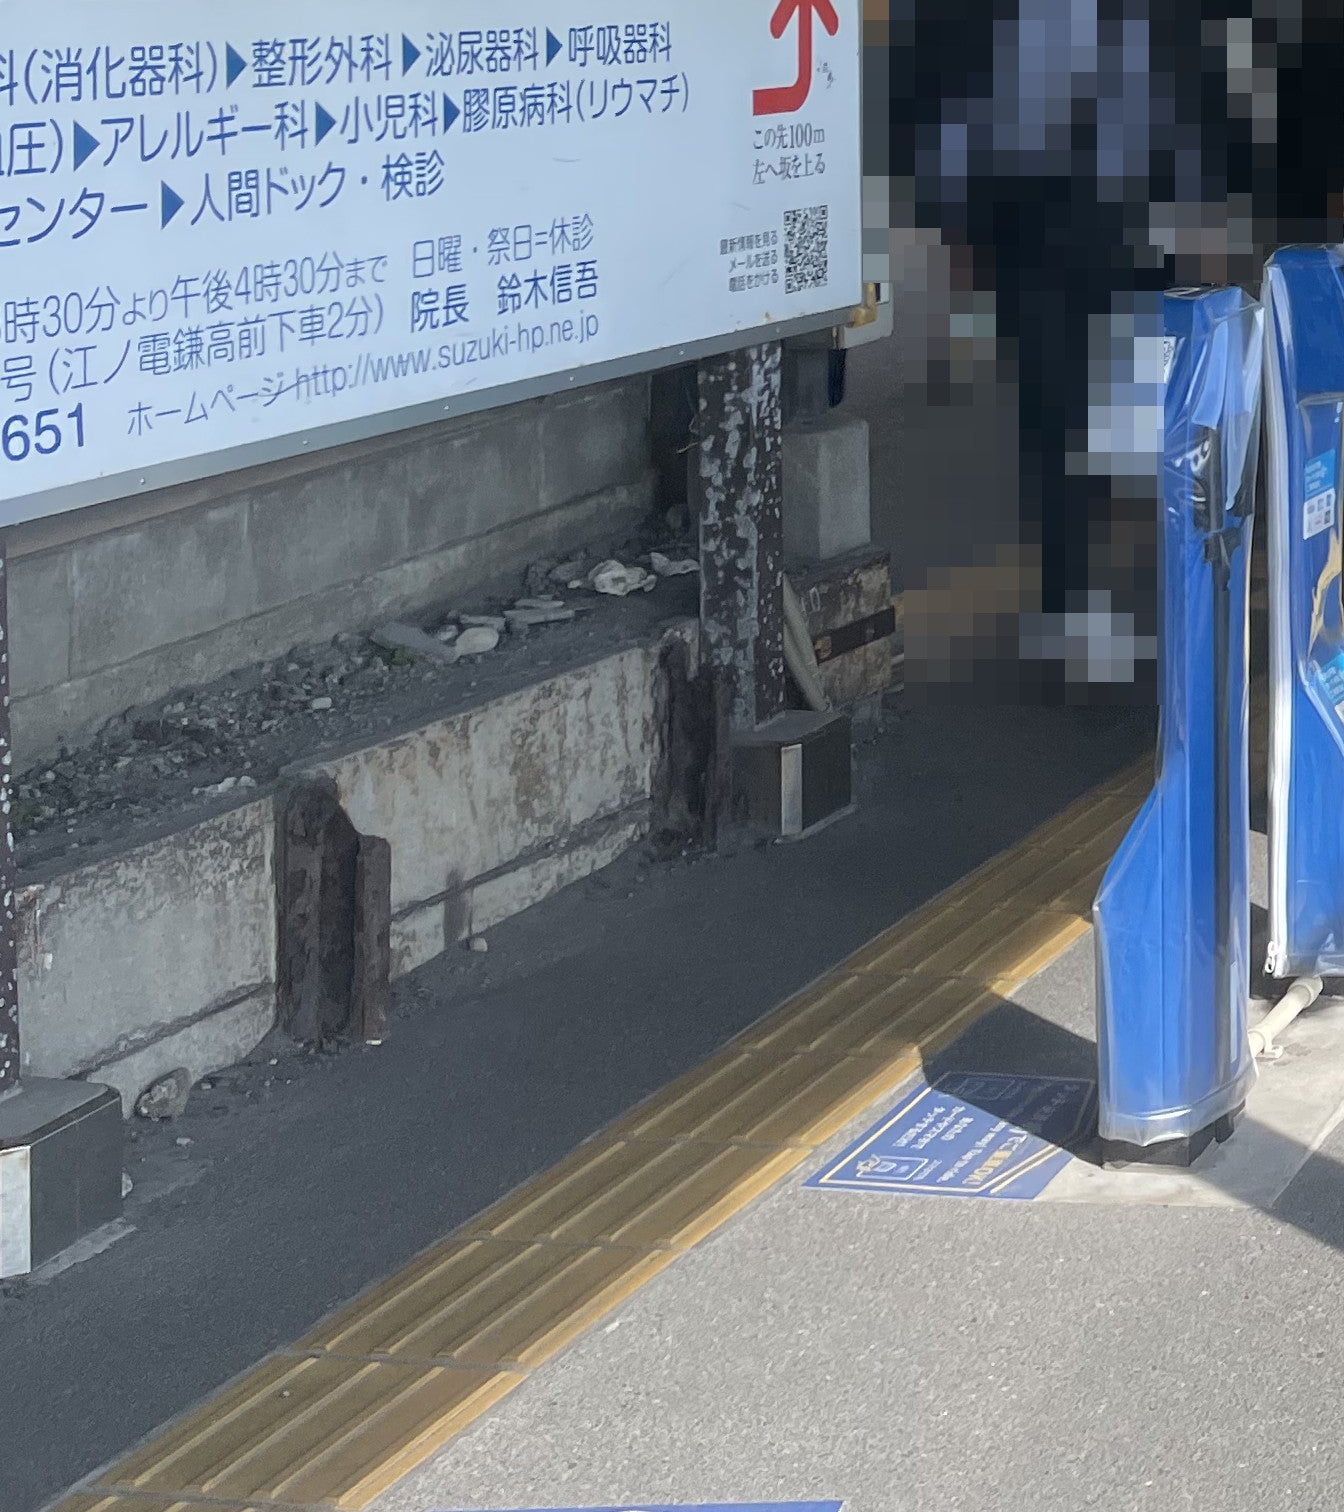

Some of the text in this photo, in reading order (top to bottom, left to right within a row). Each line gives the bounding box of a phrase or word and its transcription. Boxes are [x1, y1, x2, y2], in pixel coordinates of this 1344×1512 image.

[252, 32, 392, 88] 整形外科
[426, 26, 539, 78] 泌尿器科
[568, 21, 671, 68] 呼吸器科
[0, 72, 689, 177] 圧) アレルギー科 小児科 膠原病科(リウマチ)
[753, 123, 825, 149] この先100m
[191, 149, 444, 225] 人間ドック・検診
[752, 153, 826, 185] 左へ坂を上る
[0, 250, 388, 345] 時30分より午後4時30分まで
[410, 284, 469, 334] 院長
[497, 259, 599, 315] 鈴木信吾
[2, 402, 84, 461] 651
[128, 371, 285, 436] ホームページ
